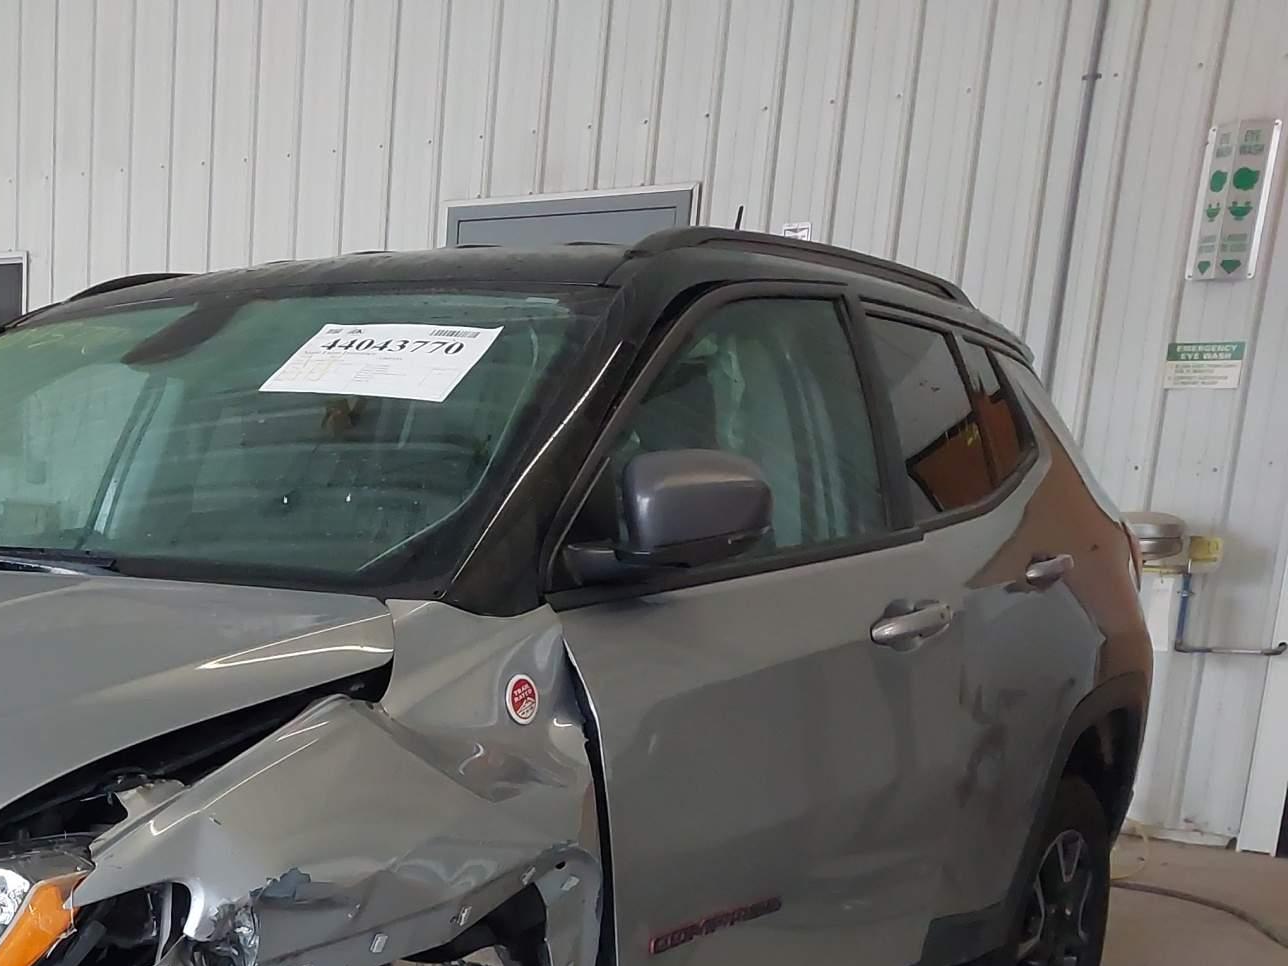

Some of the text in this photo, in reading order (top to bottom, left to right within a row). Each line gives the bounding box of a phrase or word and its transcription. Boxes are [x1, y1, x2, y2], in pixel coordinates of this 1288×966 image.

[321, 338, 465, 355] 44043770
[1176, 344, 1238, 353] EMERGENCY
[1180, 352, 1232, 360] EYE WASH
[650, 897, 782, 955] COMP
